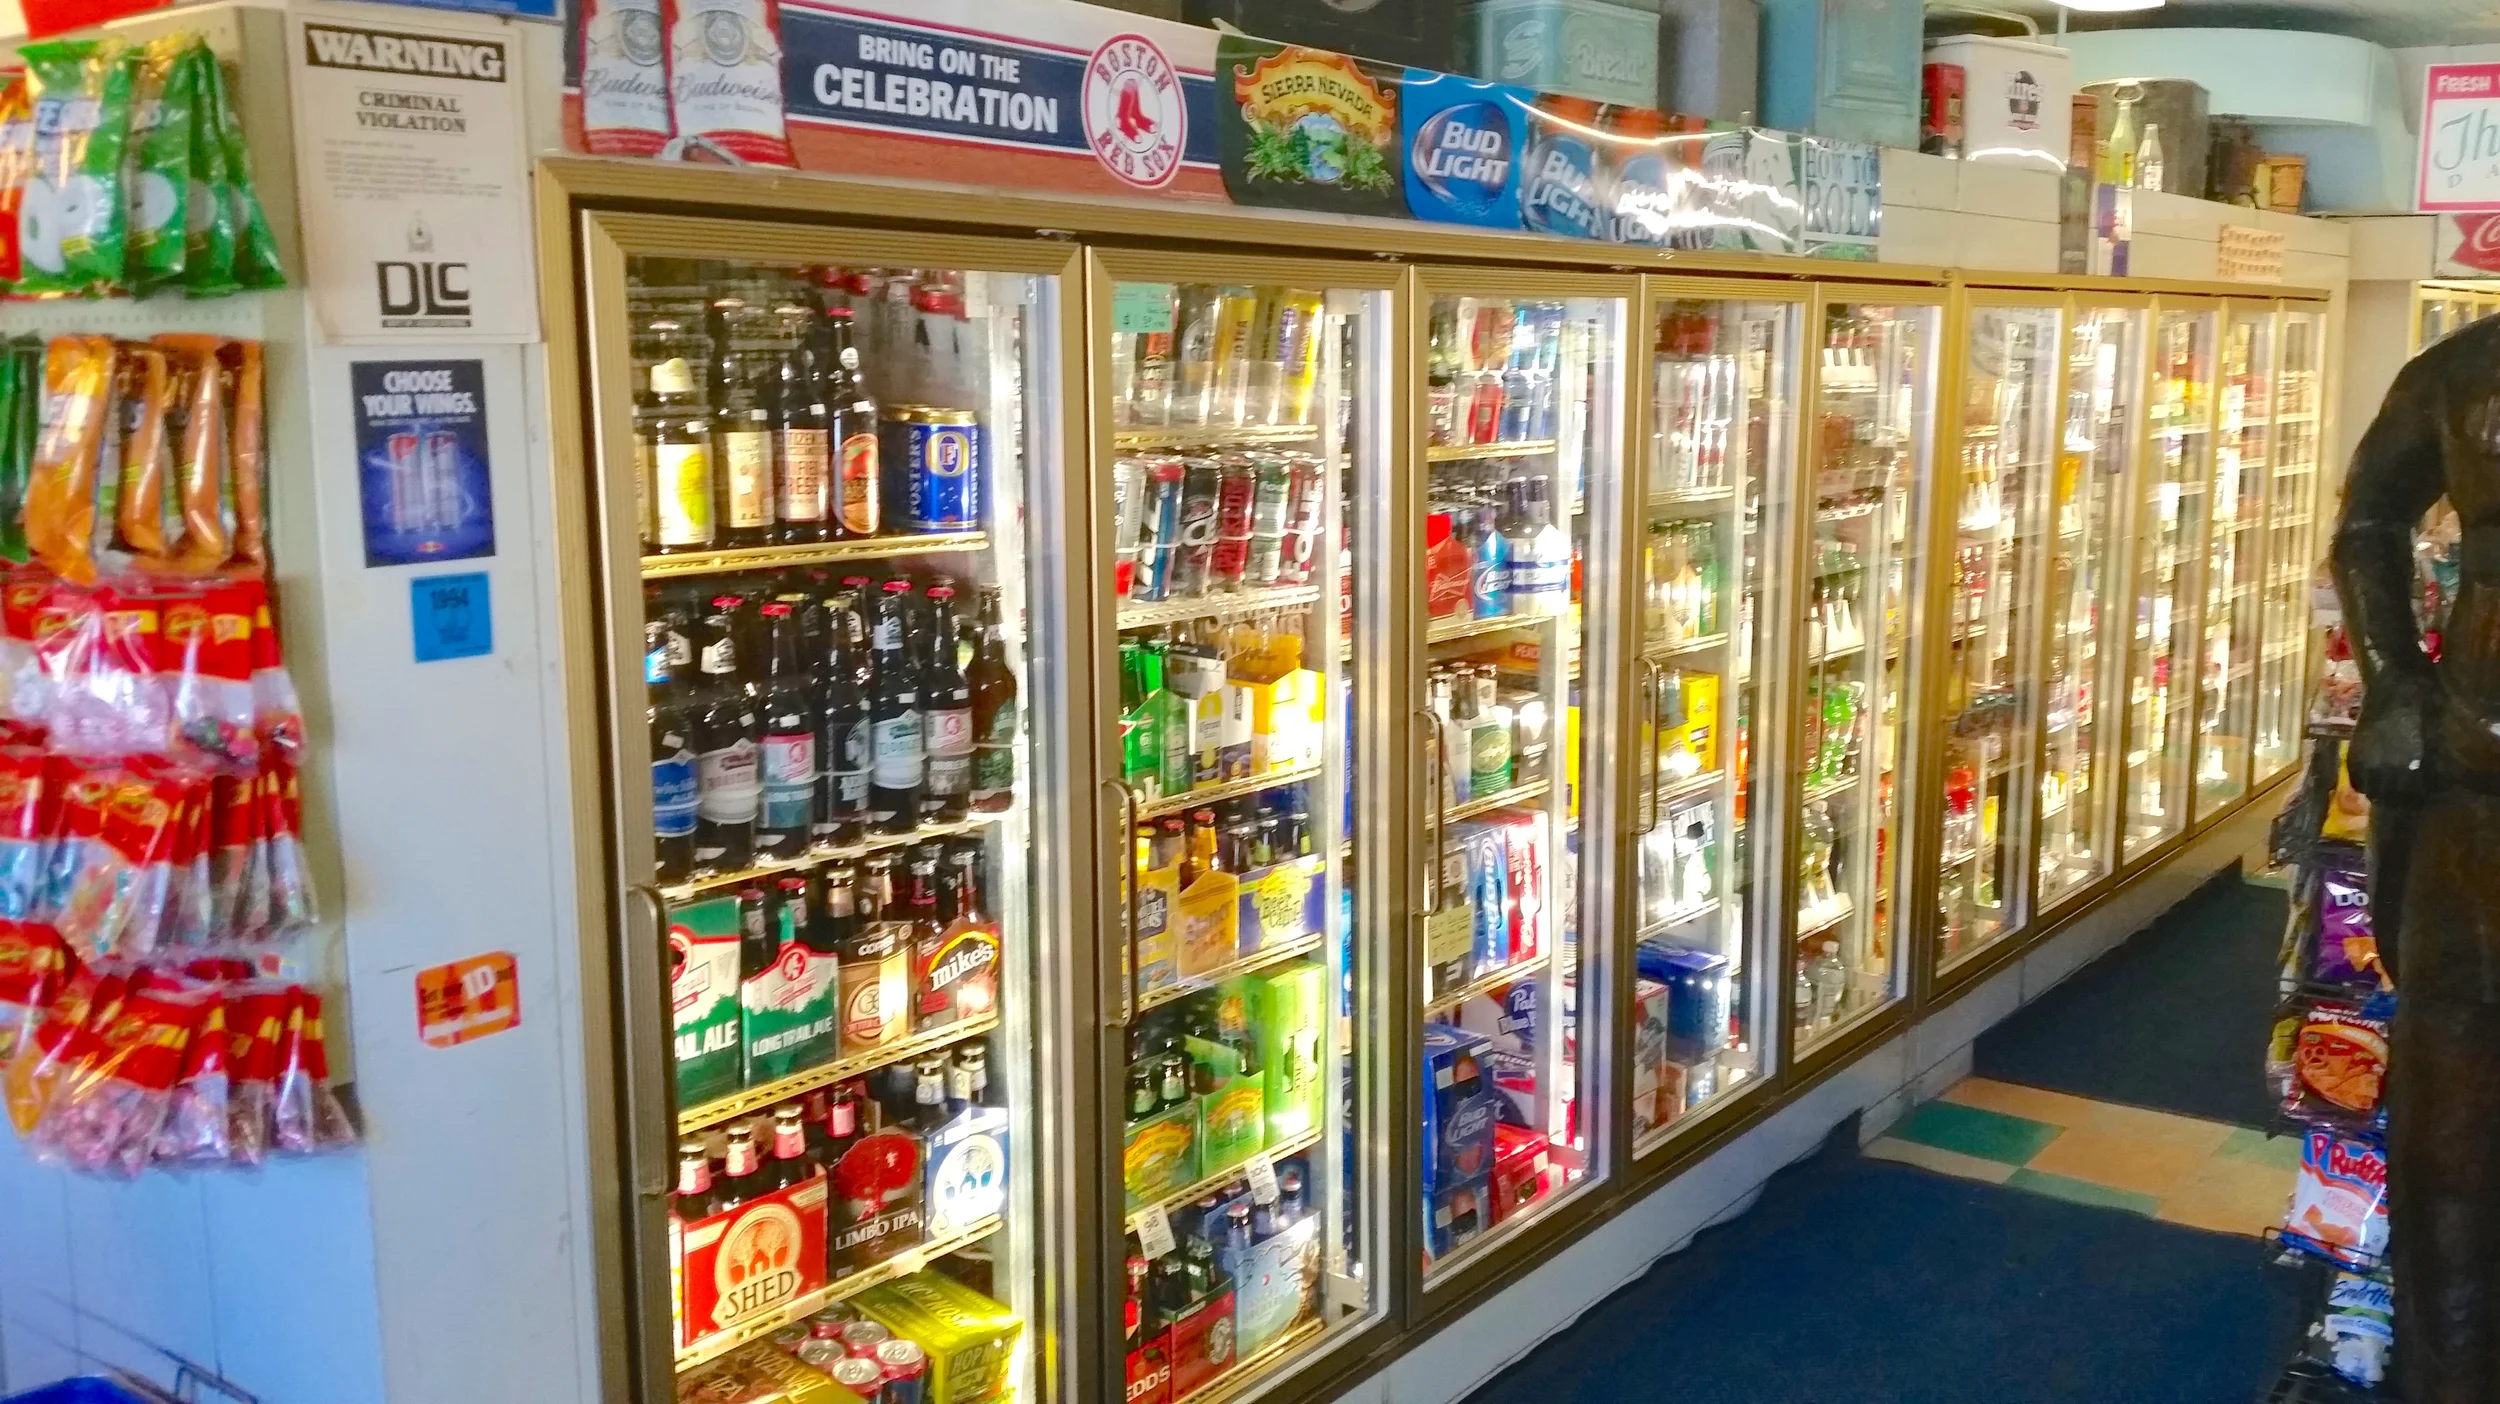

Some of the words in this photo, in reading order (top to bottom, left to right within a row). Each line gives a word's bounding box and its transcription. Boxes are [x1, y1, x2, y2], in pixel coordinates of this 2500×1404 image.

[308, 29, 501, 78] WARNING
[858, 34, 934, 70] BRING
[939, 47, 976, 77] ON
[980, 54, 1021, 84] THE
[1096, 41, 1171, 95] BOSTON
[359, 91, 461, 113] CRIMINAL
[813, 63, 1058, 134] CELEBRATION
[1261, 76, 1315, 104] SIERRA
[1317, 75, 1374, 119] NEVADA
[2437, 75, 2492, 93] FRESH
[356, 111, 467, 132] VIOLATION
[1442, 122, 1502, 155] BUD
[1098, 132, 1135, 176] RED
[1147, 136, 1175, 178] SOX
[1428, 149, 1509, 183] LIGHT
[377, 261, 471, 316] DLC
[383, 370, 453, 394] CHOOSE
[362, 394, 413, 417] YOUR
[930, 942, 995, 992] mike's
[702, 1019, 739, 1055] ALE
[752, 1034, 782, 1058] LONG
[1453, 1118, 1489, 1141] LIGHT
[1459, 1107, 1487, 1127] BUD
[835, 1219, 889, 1251] LIMBO
[893, 1210, 918, 1232] IPA
[724, 1270, 795, 1320] SHED
